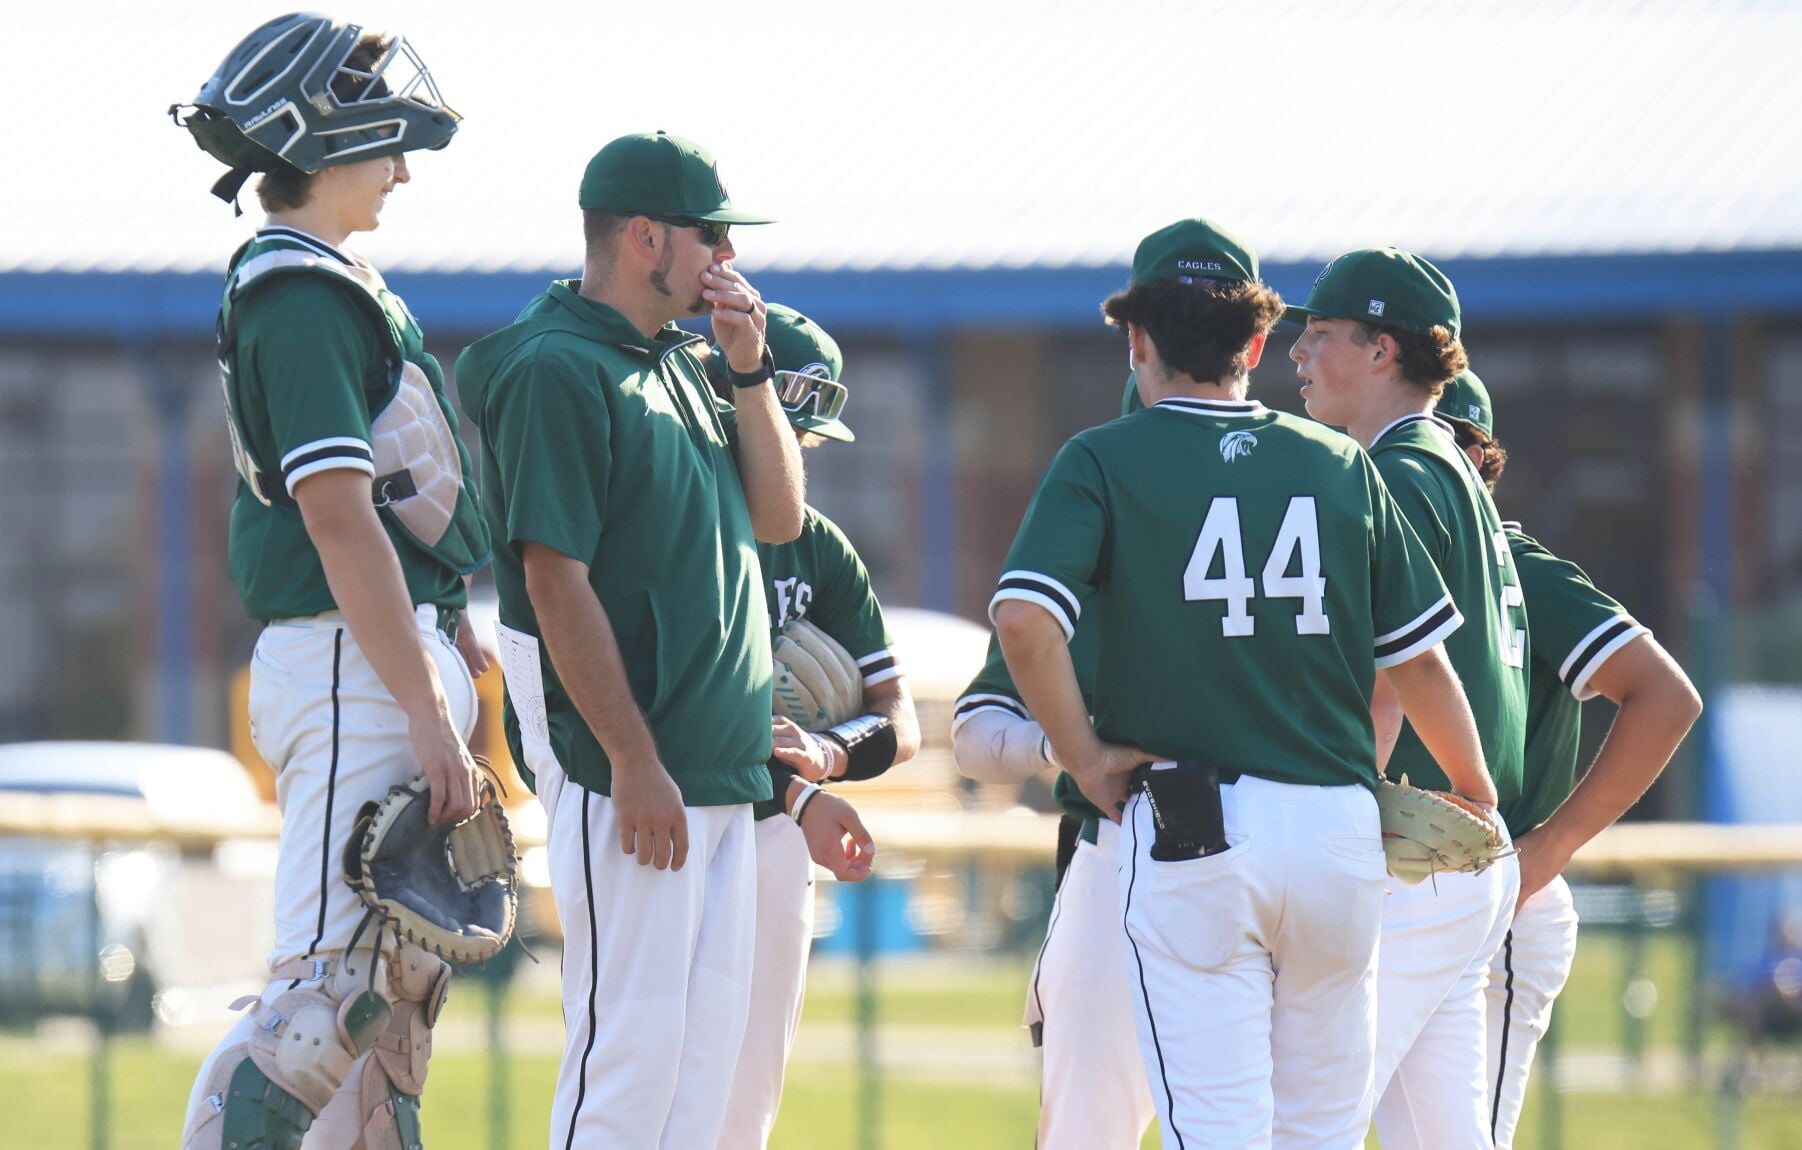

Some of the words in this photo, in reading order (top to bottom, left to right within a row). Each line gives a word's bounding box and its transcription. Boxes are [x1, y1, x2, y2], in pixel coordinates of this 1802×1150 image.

[1177, 260, 1222, 271] EAGLES
[1182, 495, 1332, 638] 44
[1142, 780, 1165, 829] EVOSHIELD
